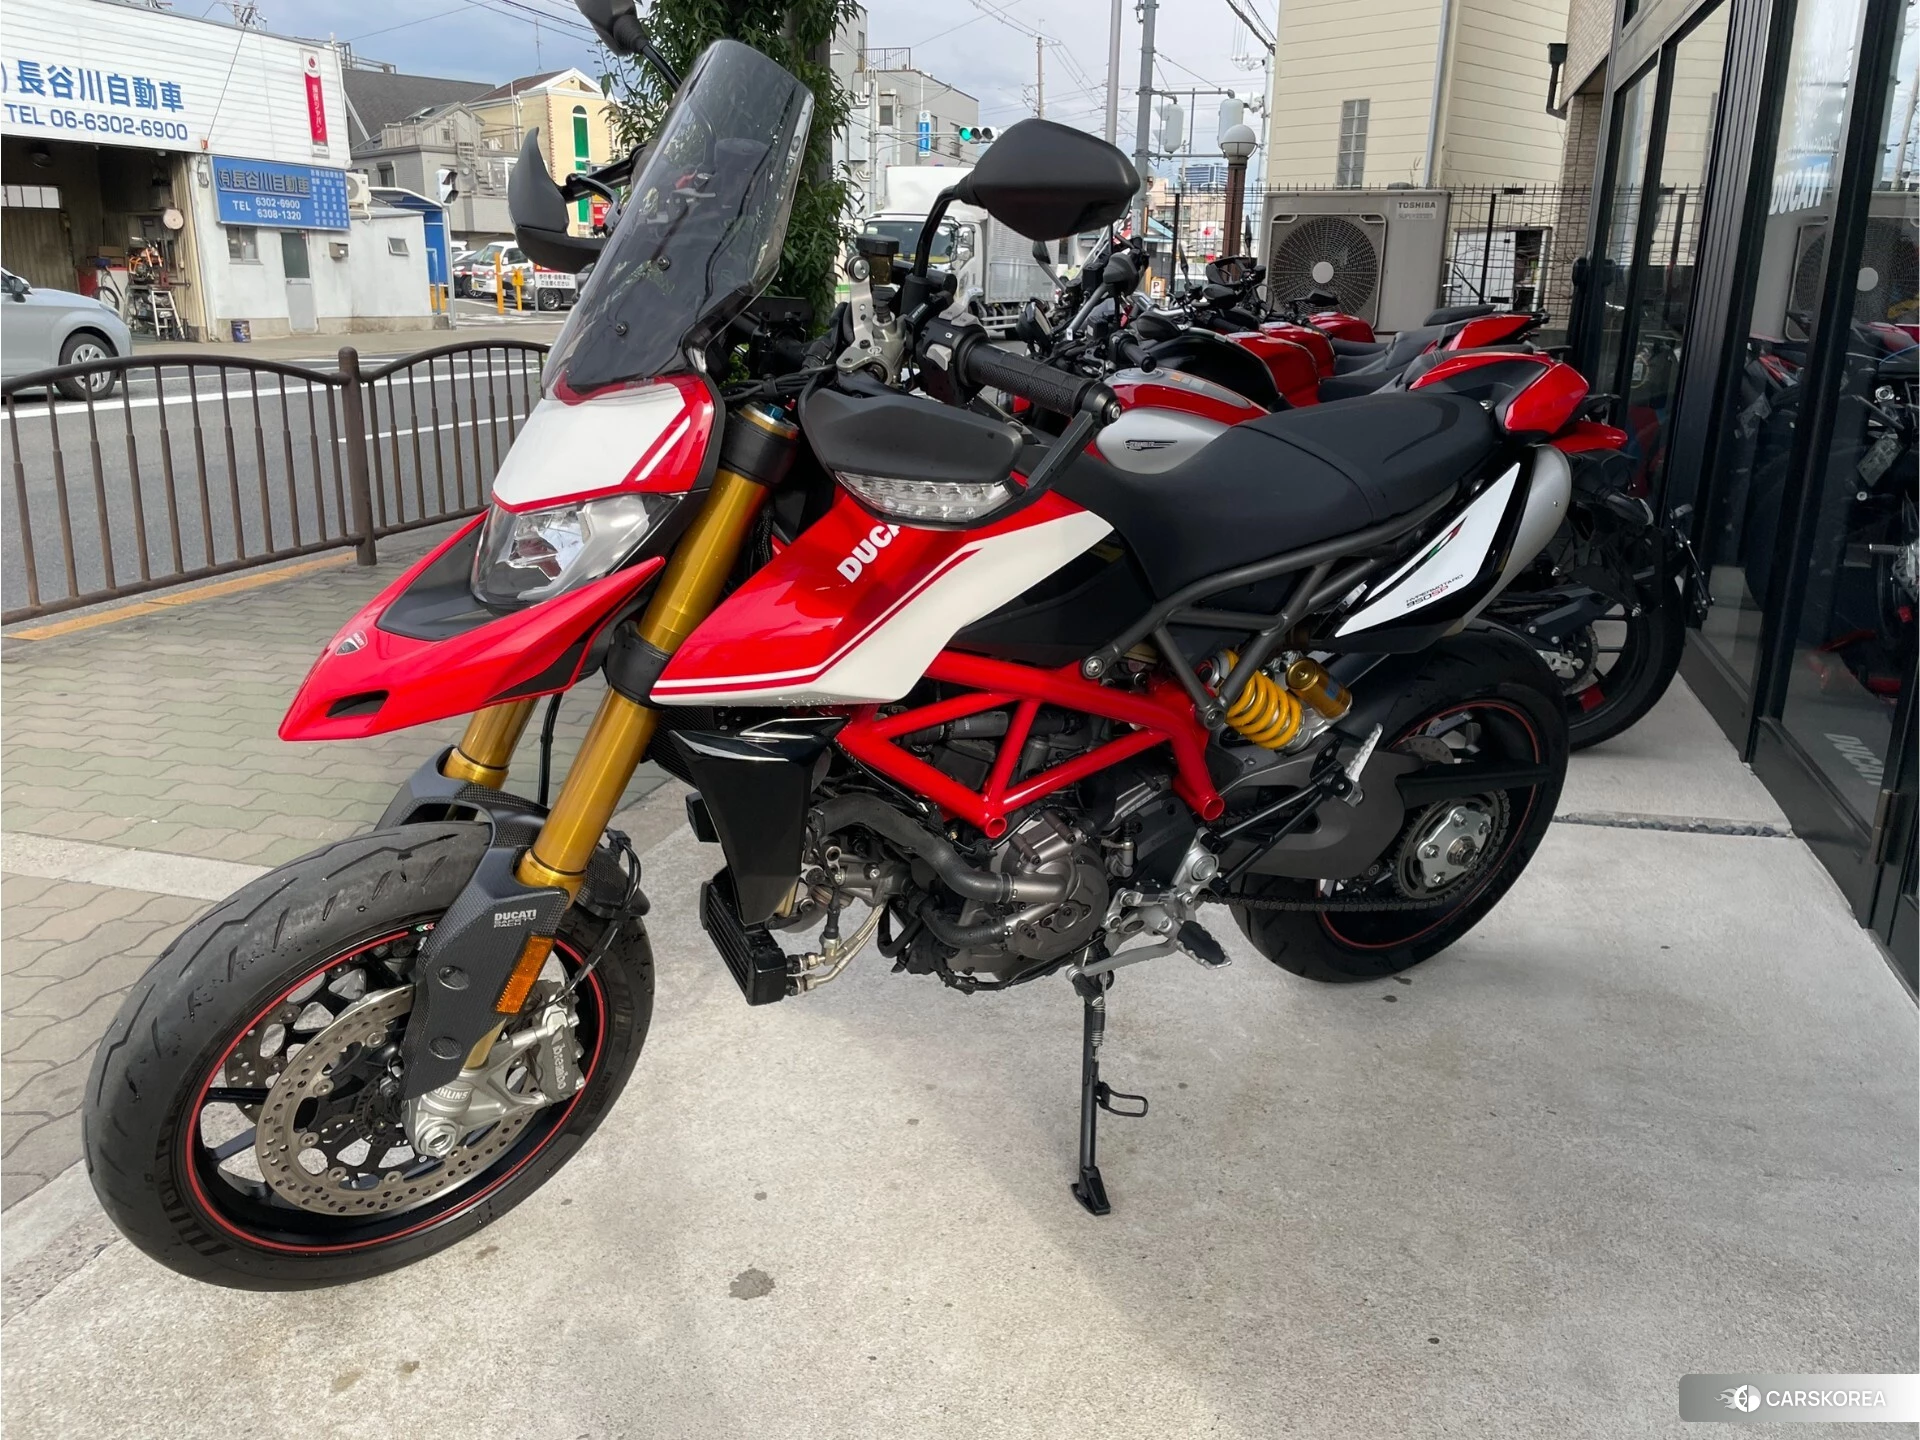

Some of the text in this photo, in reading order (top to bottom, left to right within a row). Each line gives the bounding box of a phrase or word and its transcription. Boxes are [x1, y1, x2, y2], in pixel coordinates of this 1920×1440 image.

[4, 103, 188, 141] TEL 06-6302-6900
[232, 200, 251, 211] TEL
[1398, 201, 1436, 209] TOSHIBA
[494, 909, 537, 920] DUCATI
[552, 1042, 568, 1090] brembo
